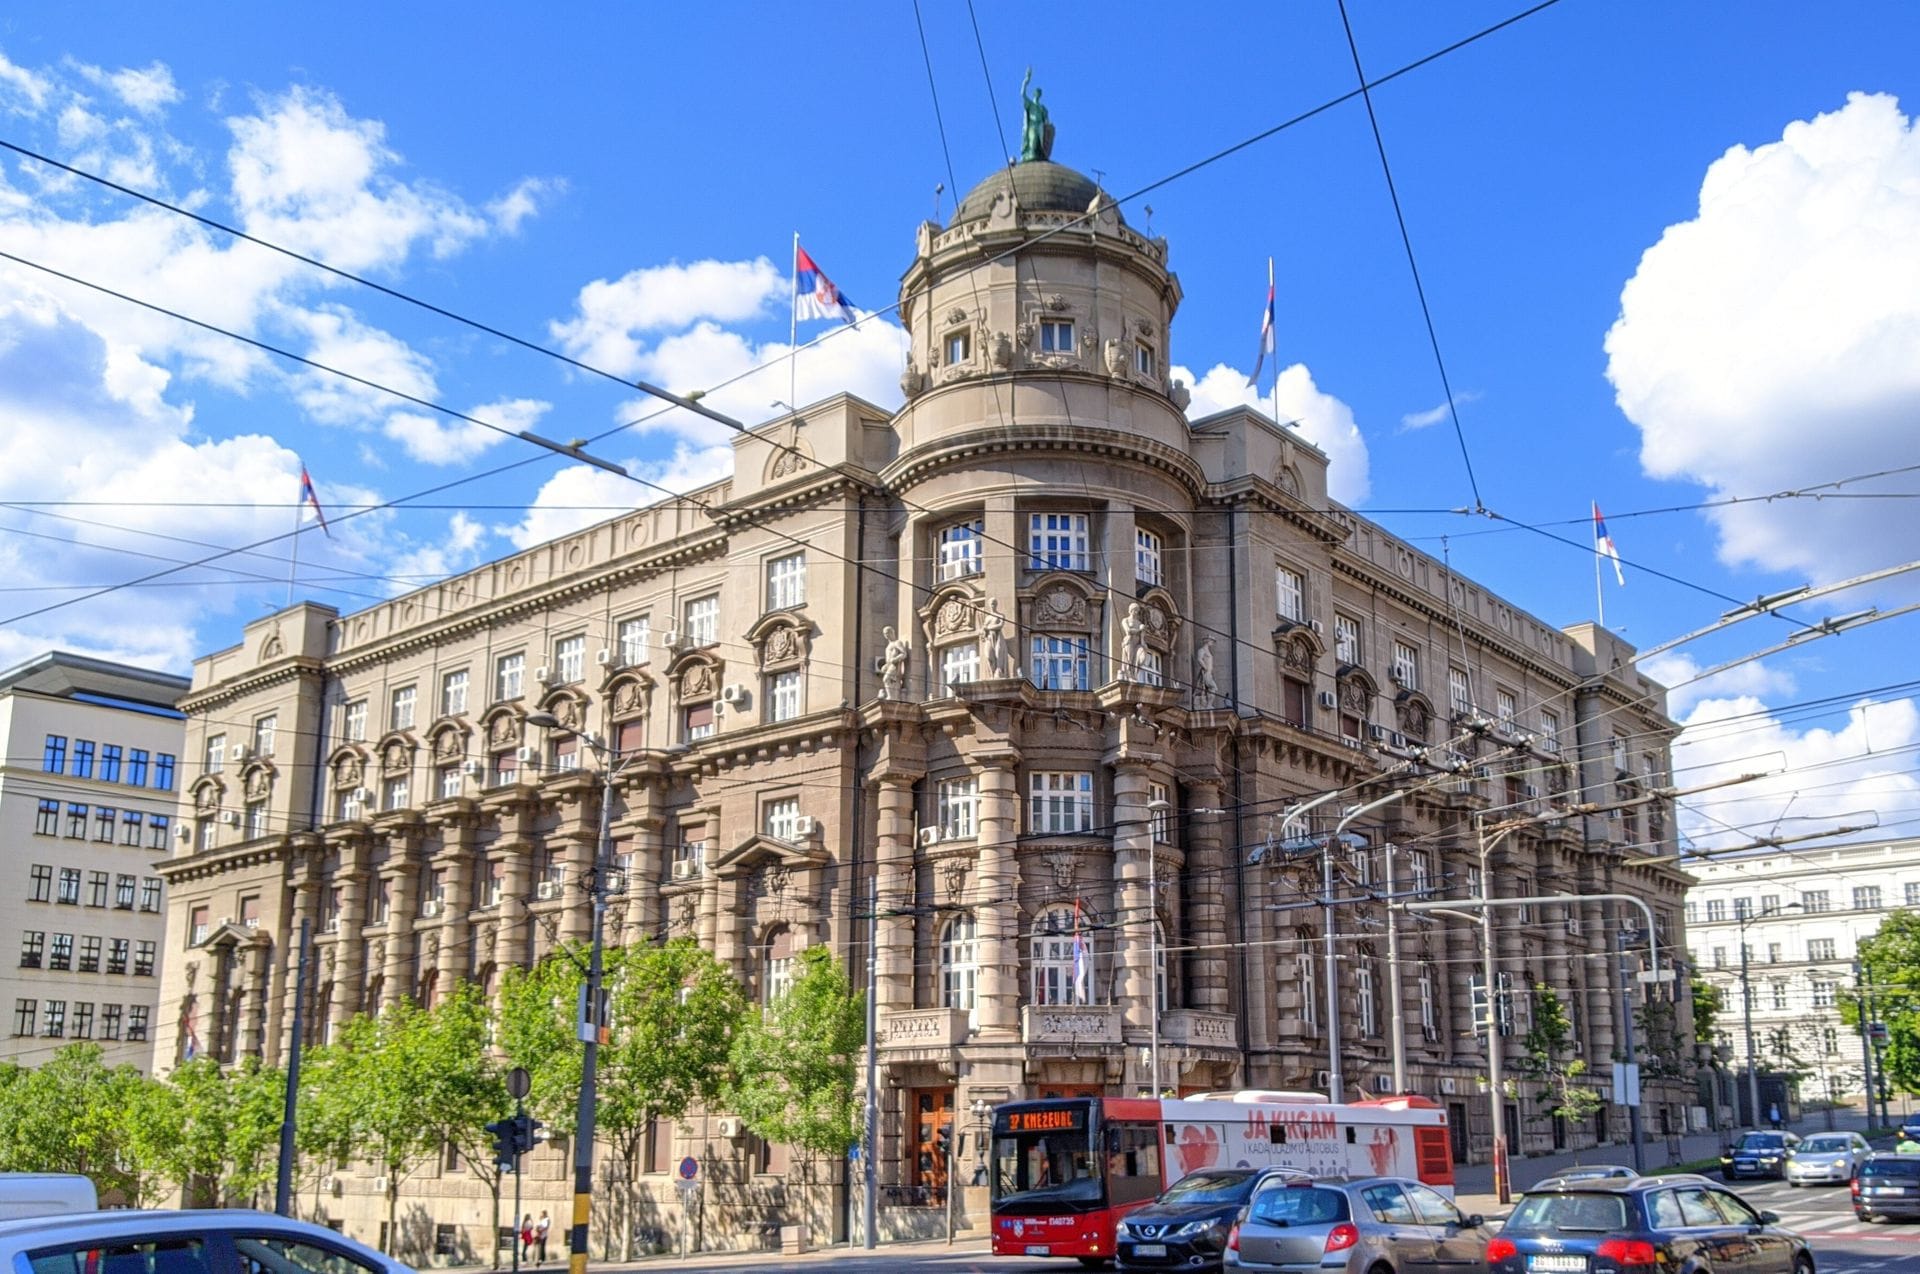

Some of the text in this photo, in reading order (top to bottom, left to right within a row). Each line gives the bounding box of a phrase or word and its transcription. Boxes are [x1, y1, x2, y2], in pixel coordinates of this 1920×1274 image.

[1009, 1114, 1020, 1130] 37
[1243, 1109, 1269, 1139] JA
[1248, 1143, 1270, 1154] KADA
[1305, 1143, 1339, 1154] AUTOBUS
